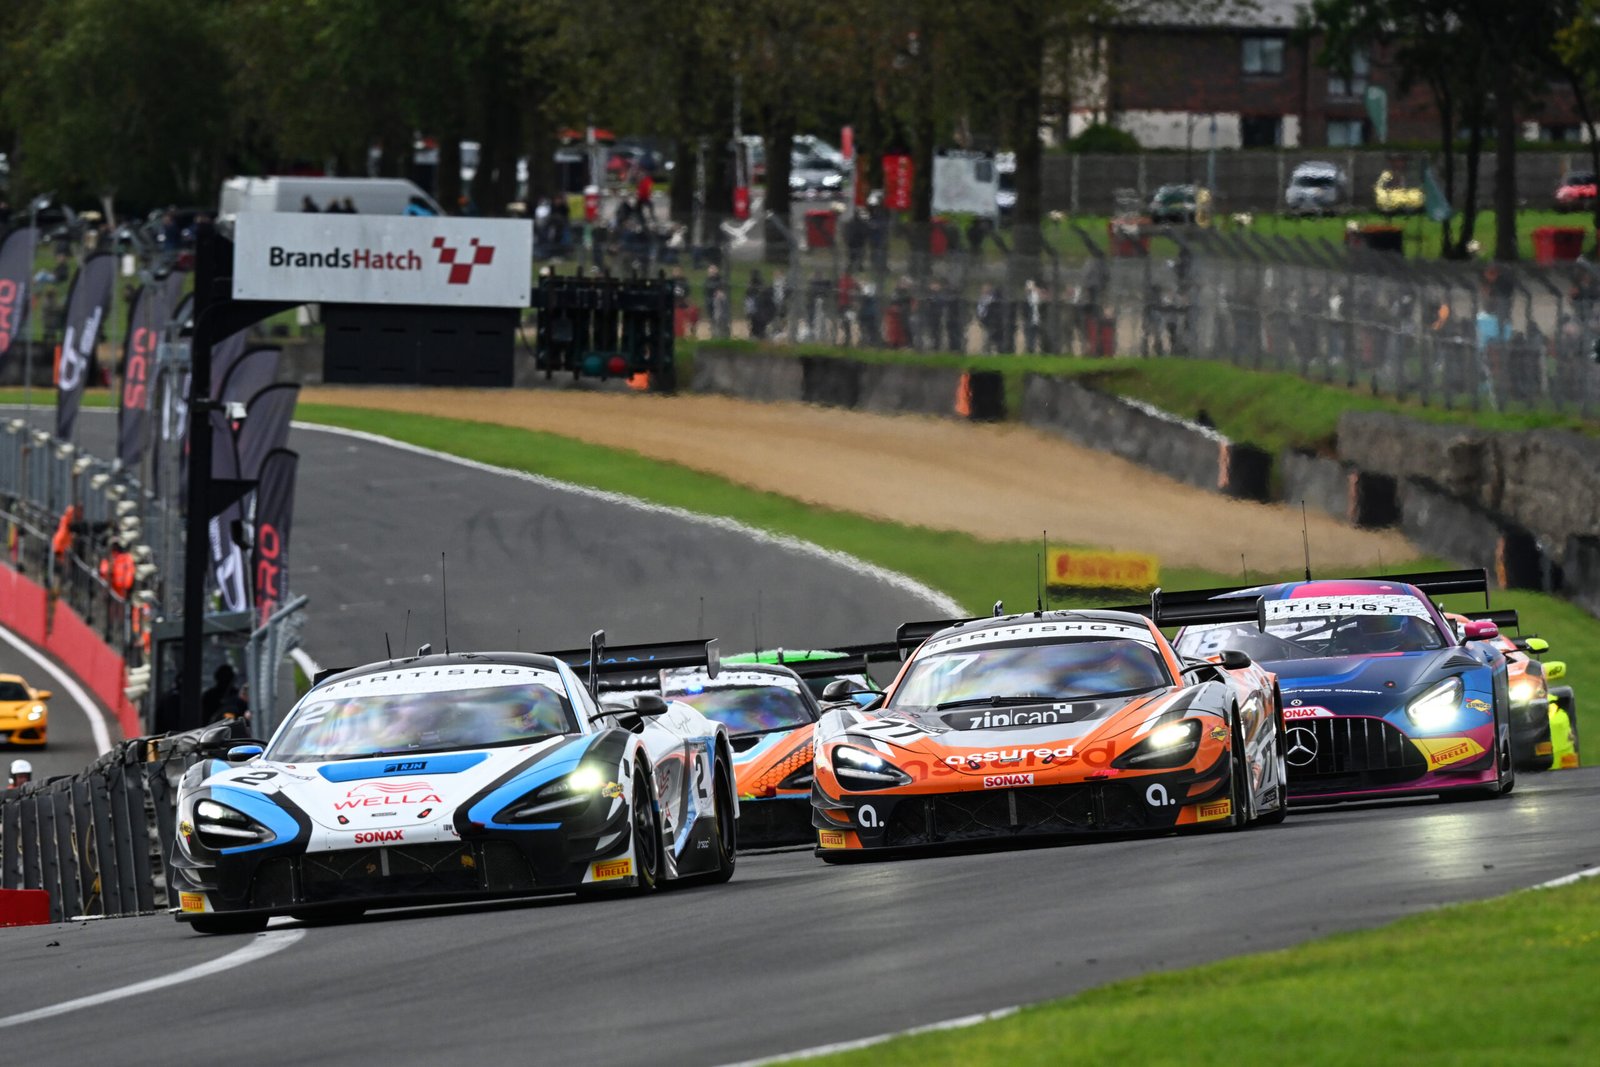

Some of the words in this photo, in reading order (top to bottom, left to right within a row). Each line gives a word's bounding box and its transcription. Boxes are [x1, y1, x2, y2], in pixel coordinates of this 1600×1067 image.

[1273, 602, 1398, 614] ITISHGT
[1284, 708, 1317, 719] ONAX
[946, 745, 1073, 765] assured
[1430, 742, 1469, 764] PIRELLI
[230, 771, 279, 786] 2
[695, 754, 708, 798] 2
[984, 774, 1031, 788] SONAX
[334, 794, 443, 810] WELLA
[1200, 802, 1229, 818] PIRELLI
[354, 829, 404, 844] SONAX
[821, 832, 843, 845] PIRELLI
[596, 861, 629, 878] PIRELLI
